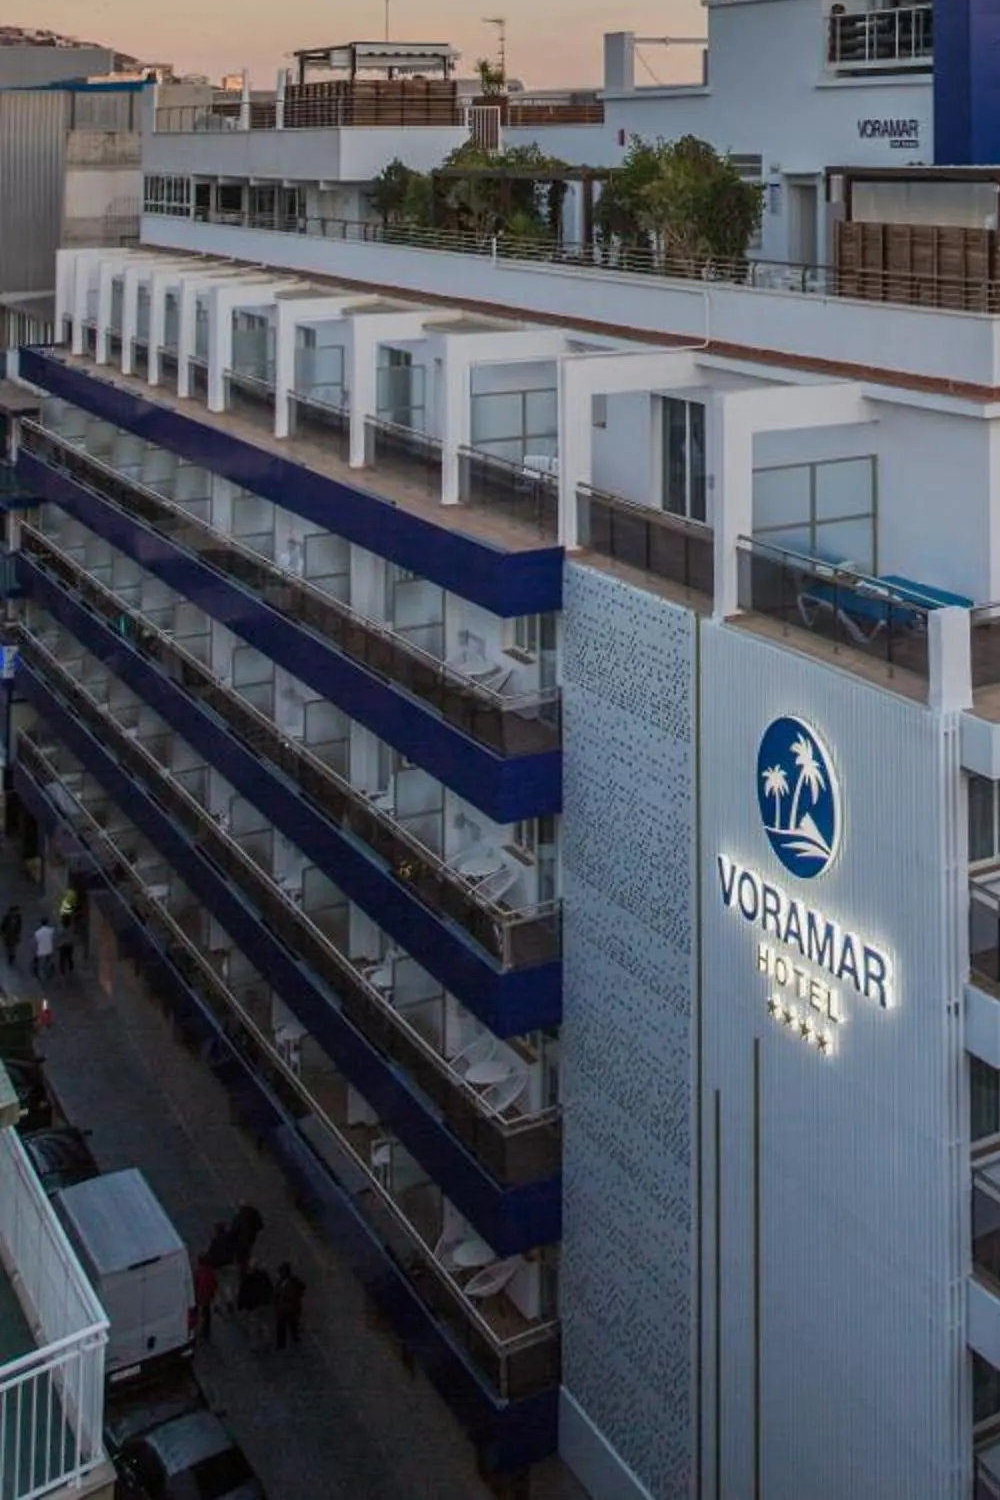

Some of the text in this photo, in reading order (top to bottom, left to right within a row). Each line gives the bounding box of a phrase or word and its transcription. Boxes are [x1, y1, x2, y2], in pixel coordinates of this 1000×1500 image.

[857, 119, 919, 138] VORAMAR
[717, 853, 889, 1009] VORAMAR
[756, 943, 840, 1024] HOTEL
